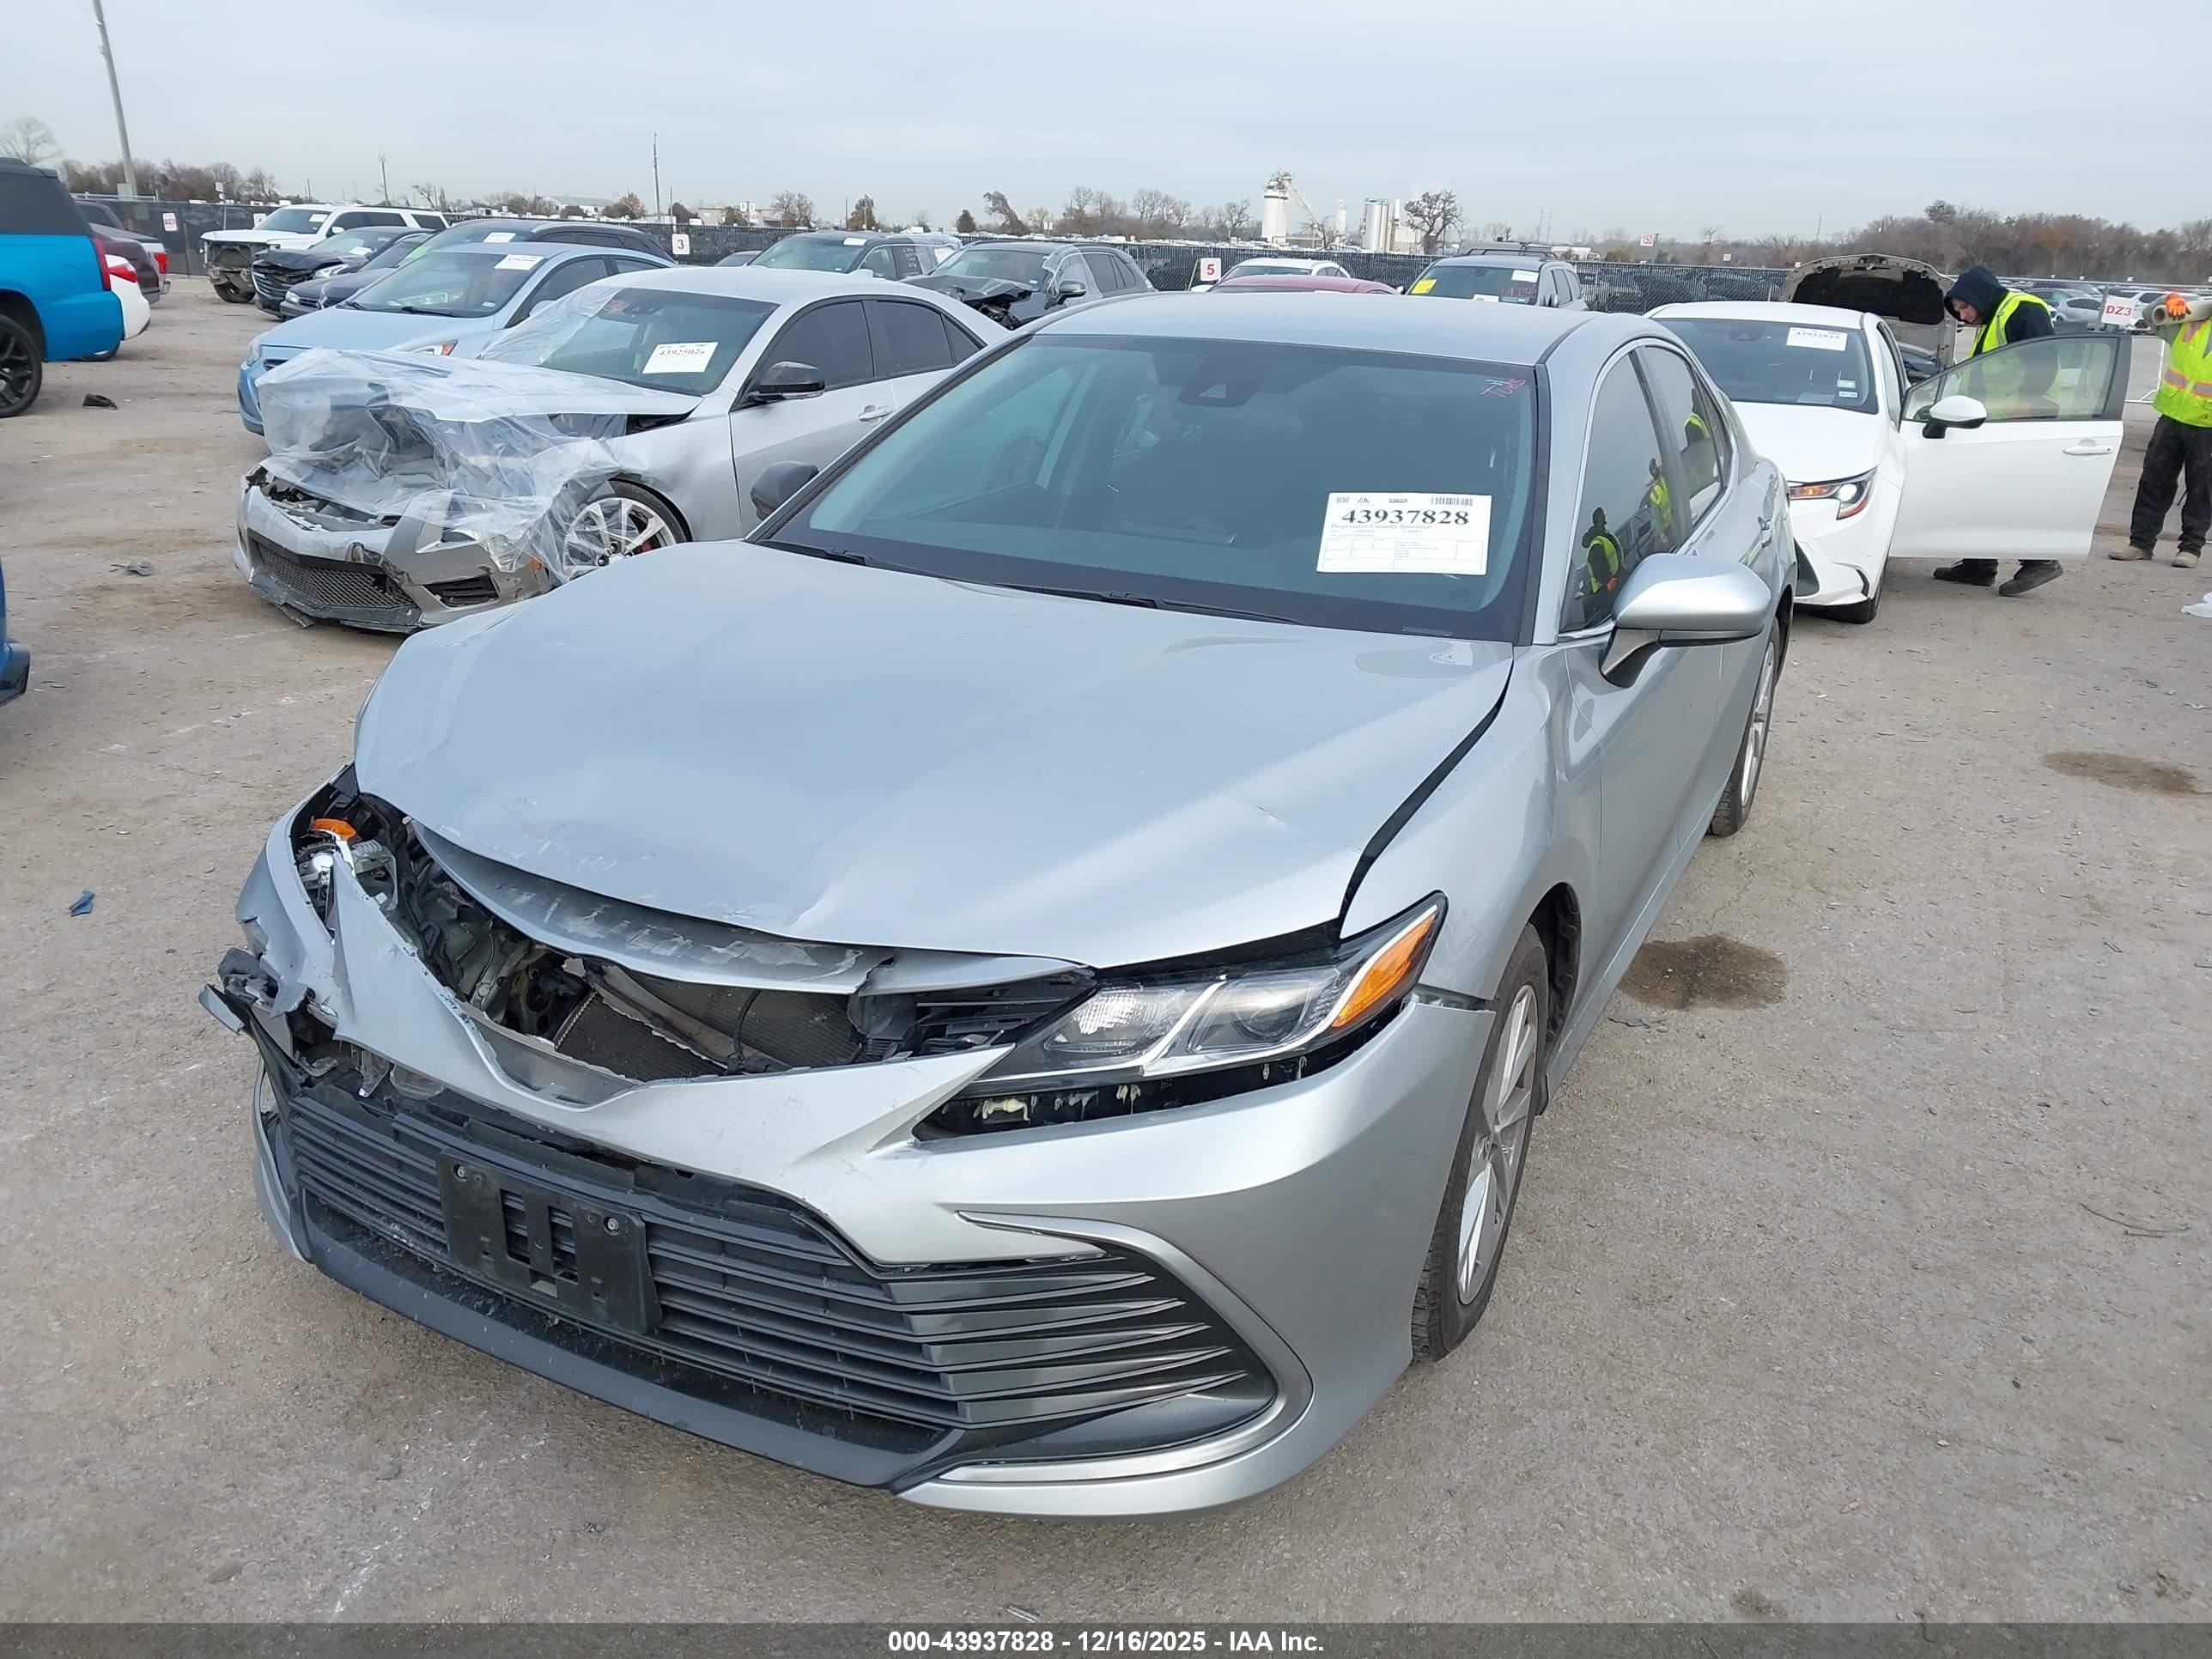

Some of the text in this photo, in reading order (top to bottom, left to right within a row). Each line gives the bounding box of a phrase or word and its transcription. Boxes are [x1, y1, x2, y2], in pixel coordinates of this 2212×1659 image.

[677, 239, 684, 250] 3
[1206, 264, 1215, 276] 5
[2106, 305, 2132, 316] DZ3
[1341, 509, 1469, 526] 43937828
